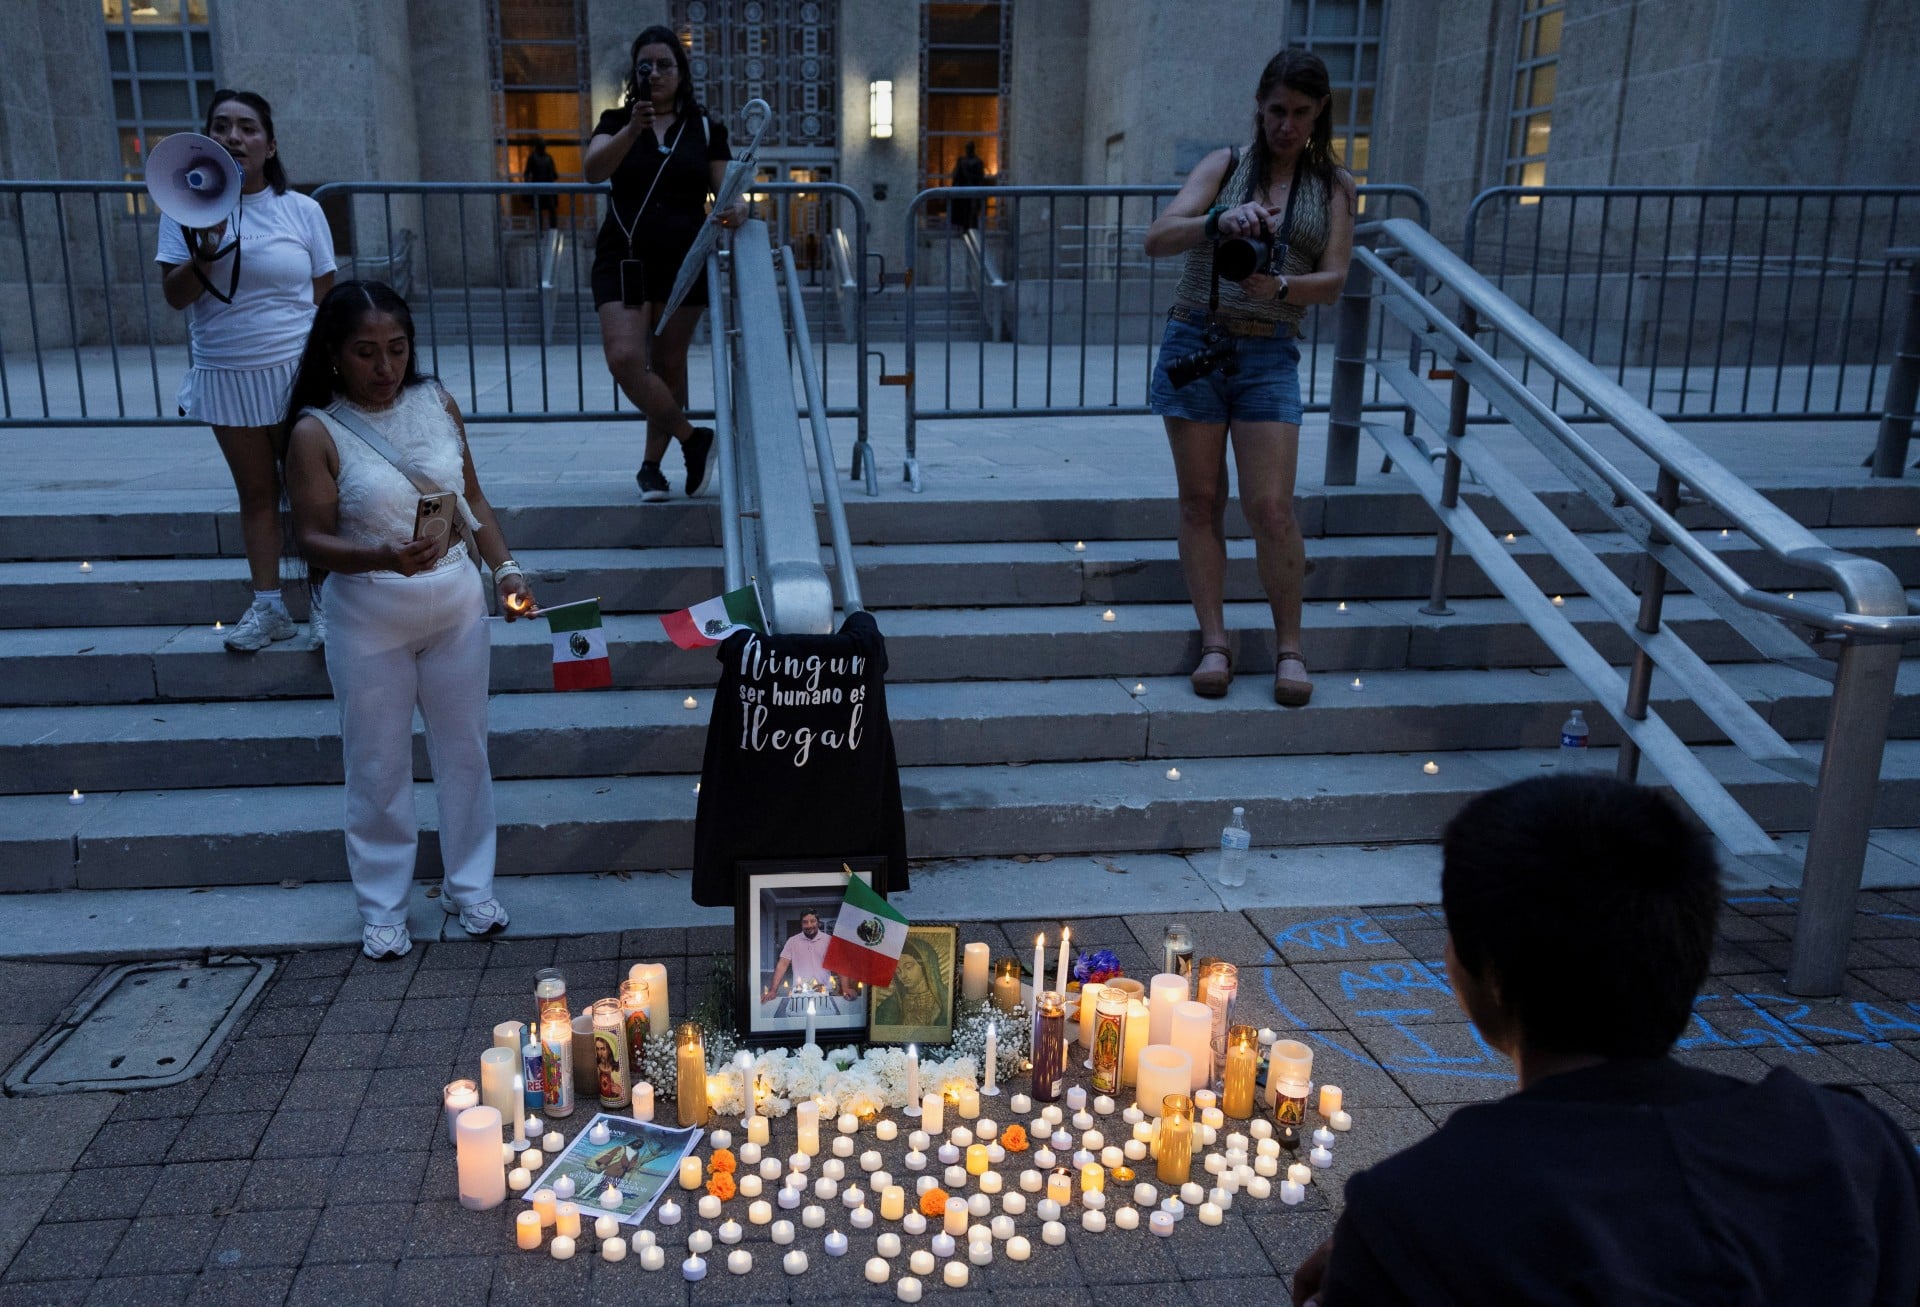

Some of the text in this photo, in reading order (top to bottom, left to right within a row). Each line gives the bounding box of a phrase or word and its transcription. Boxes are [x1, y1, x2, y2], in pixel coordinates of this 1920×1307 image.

[740, 633, 866, 692] Ningun
[739, 682, 866, 706] ser humano es
[740, 701, 863, 767] Ilegal
[1280, 918, 1395, 951] WE
